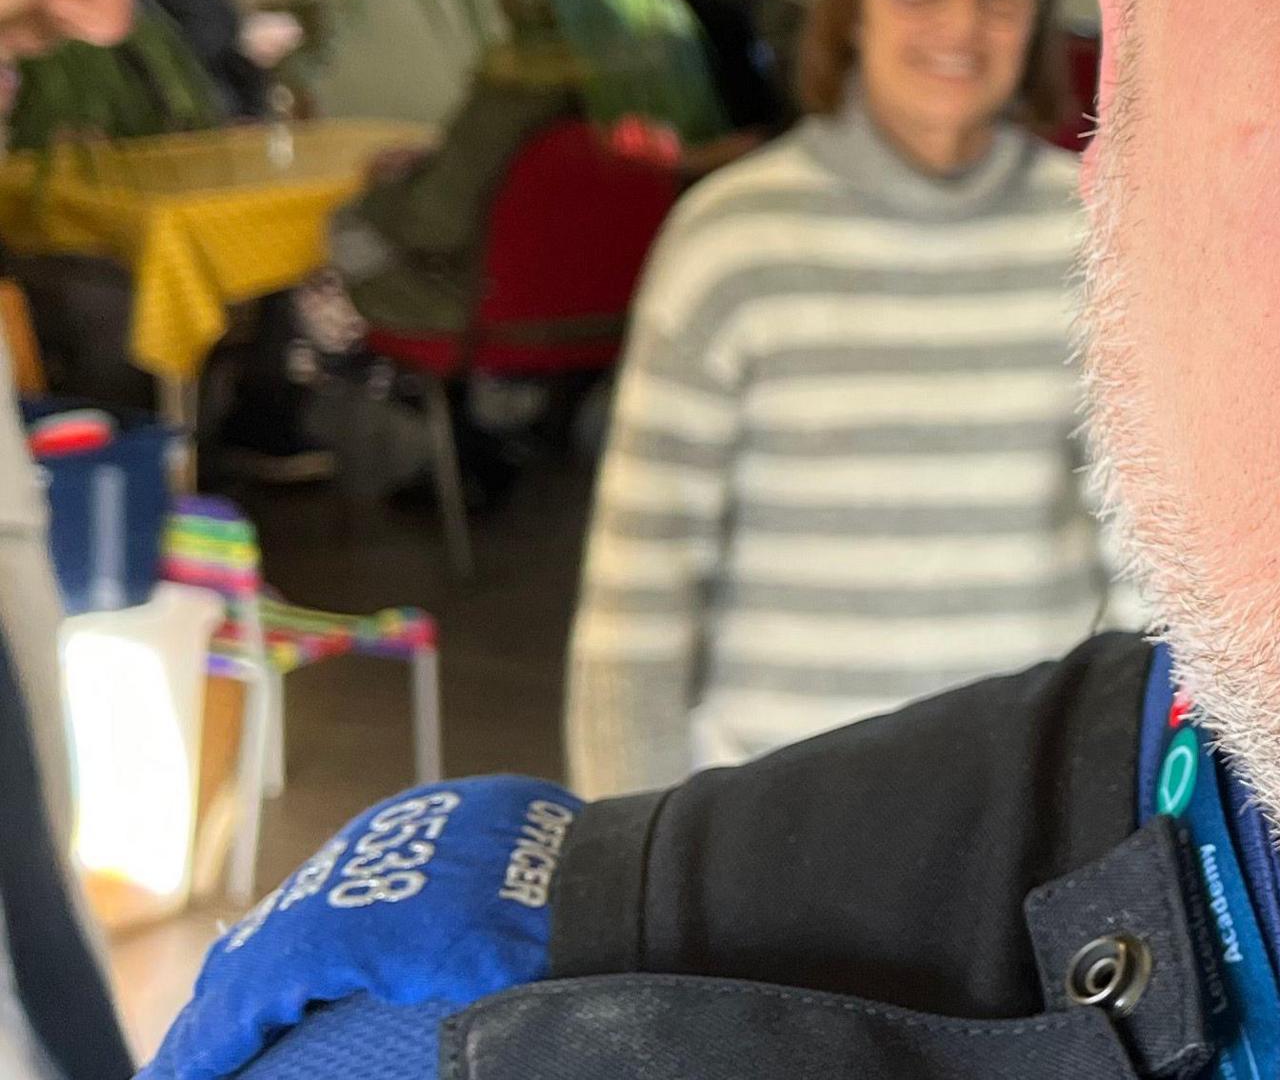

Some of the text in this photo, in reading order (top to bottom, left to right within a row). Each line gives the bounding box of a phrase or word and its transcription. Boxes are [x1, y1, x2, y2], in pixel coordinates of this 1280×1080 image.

[327, 791, 461, 909] 6538
[499, 799, 574, 909] OFFICER
[1200, 843, 1244, 963] Academy
